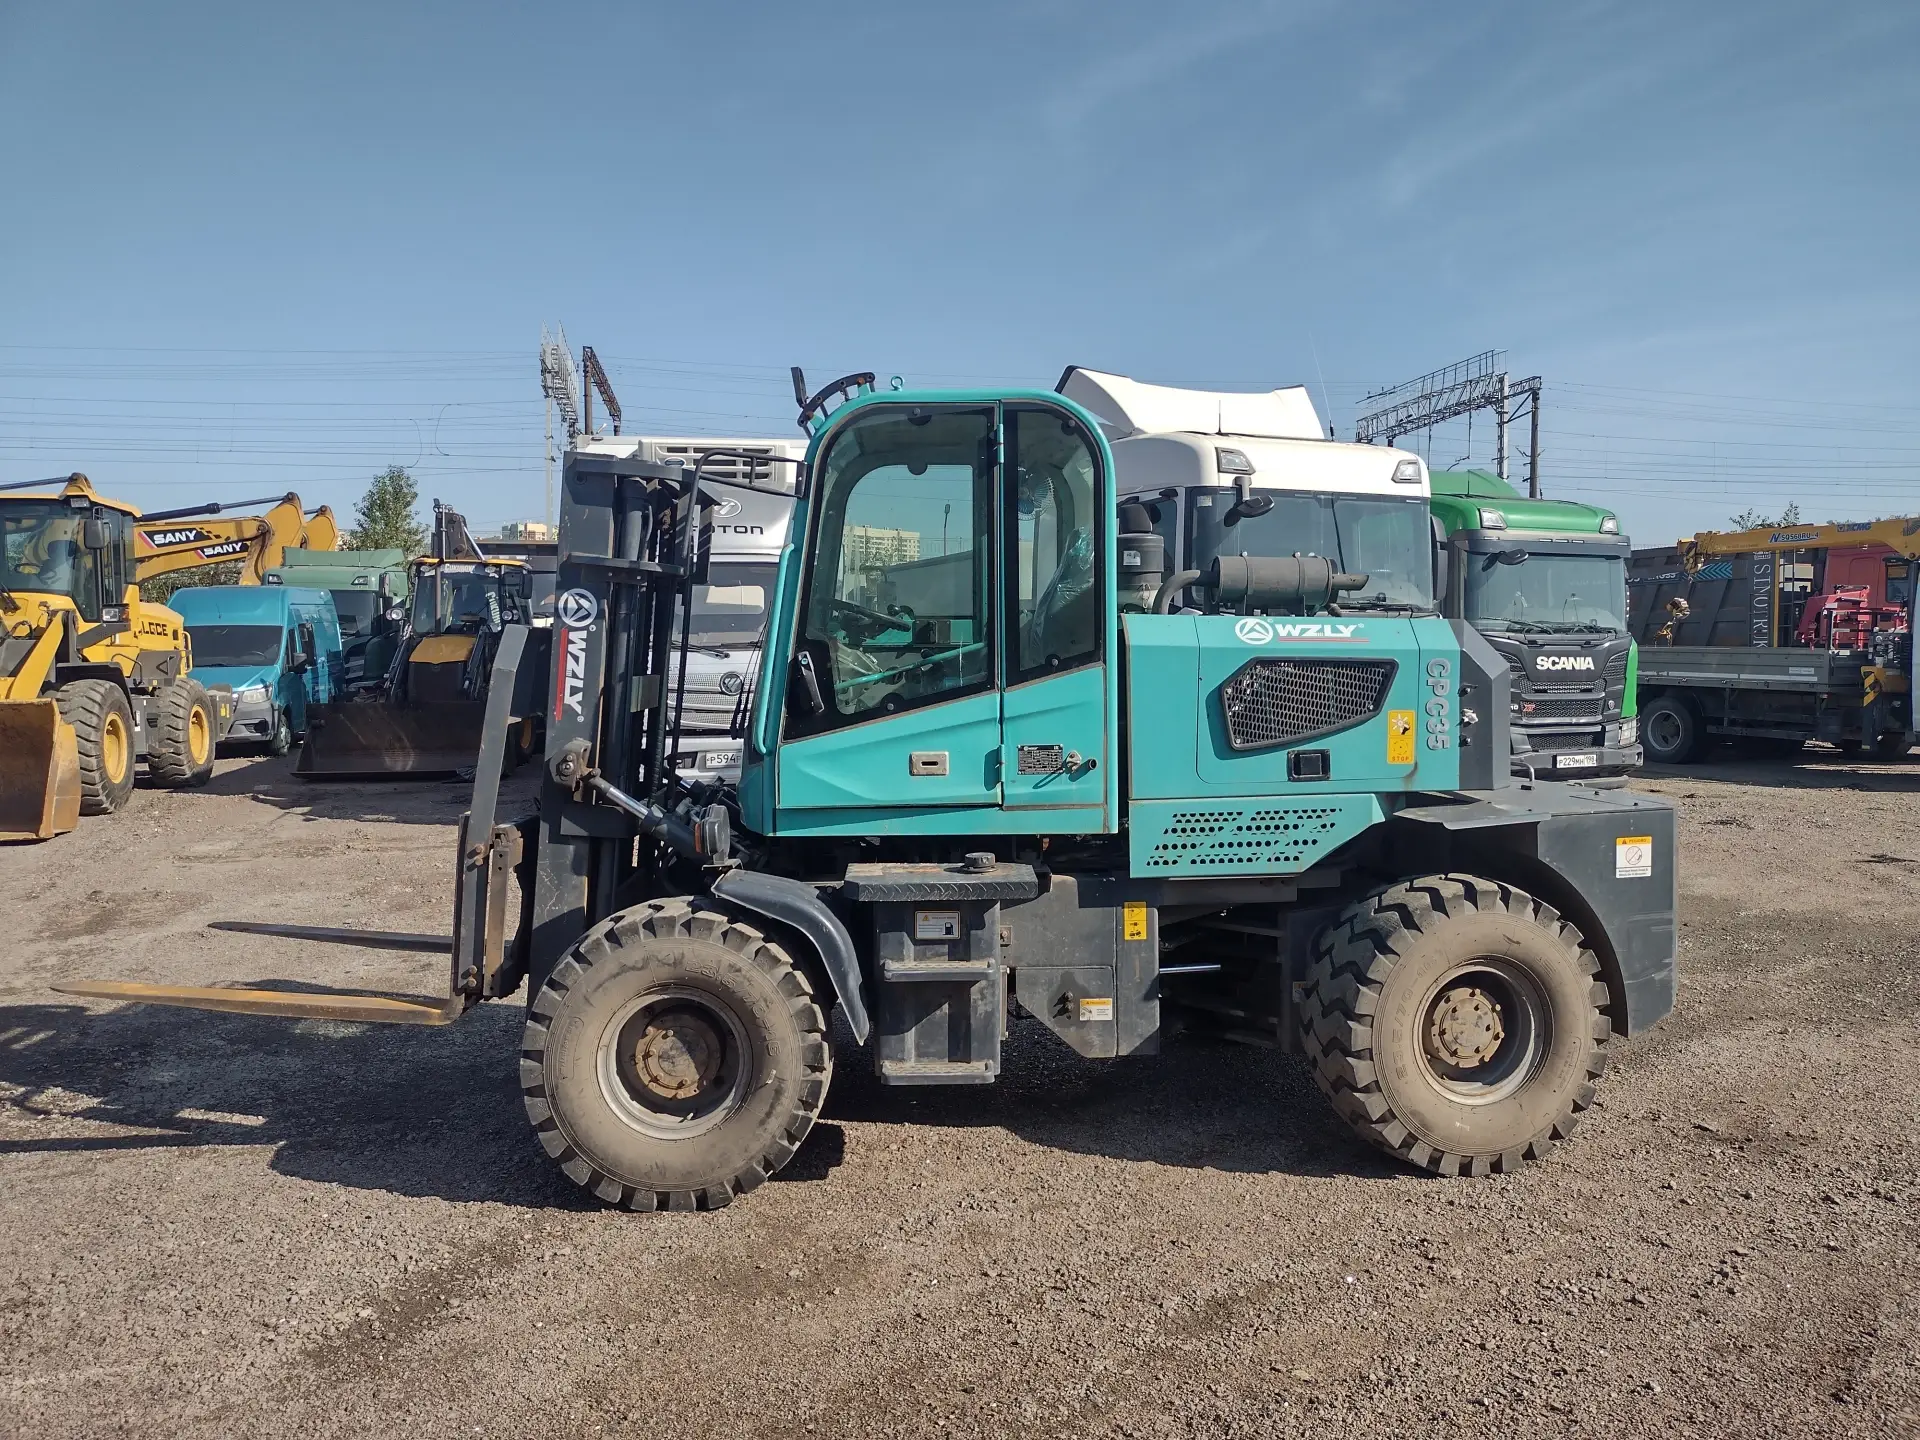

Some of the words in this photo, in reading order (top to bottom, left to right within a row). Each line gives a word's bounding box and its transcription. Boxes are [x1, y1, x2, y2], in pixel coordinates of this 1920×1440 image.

[153, 530, 197, 545] SANY
[203, 542, 242, 556] SANY
[1274, 623, 1358, 638] WZLY
[1536, 656, 1595, 671] SCANIA
[564, 630, 588, 715] WZLY
[1425, 658, 1451, 751] CPC35
